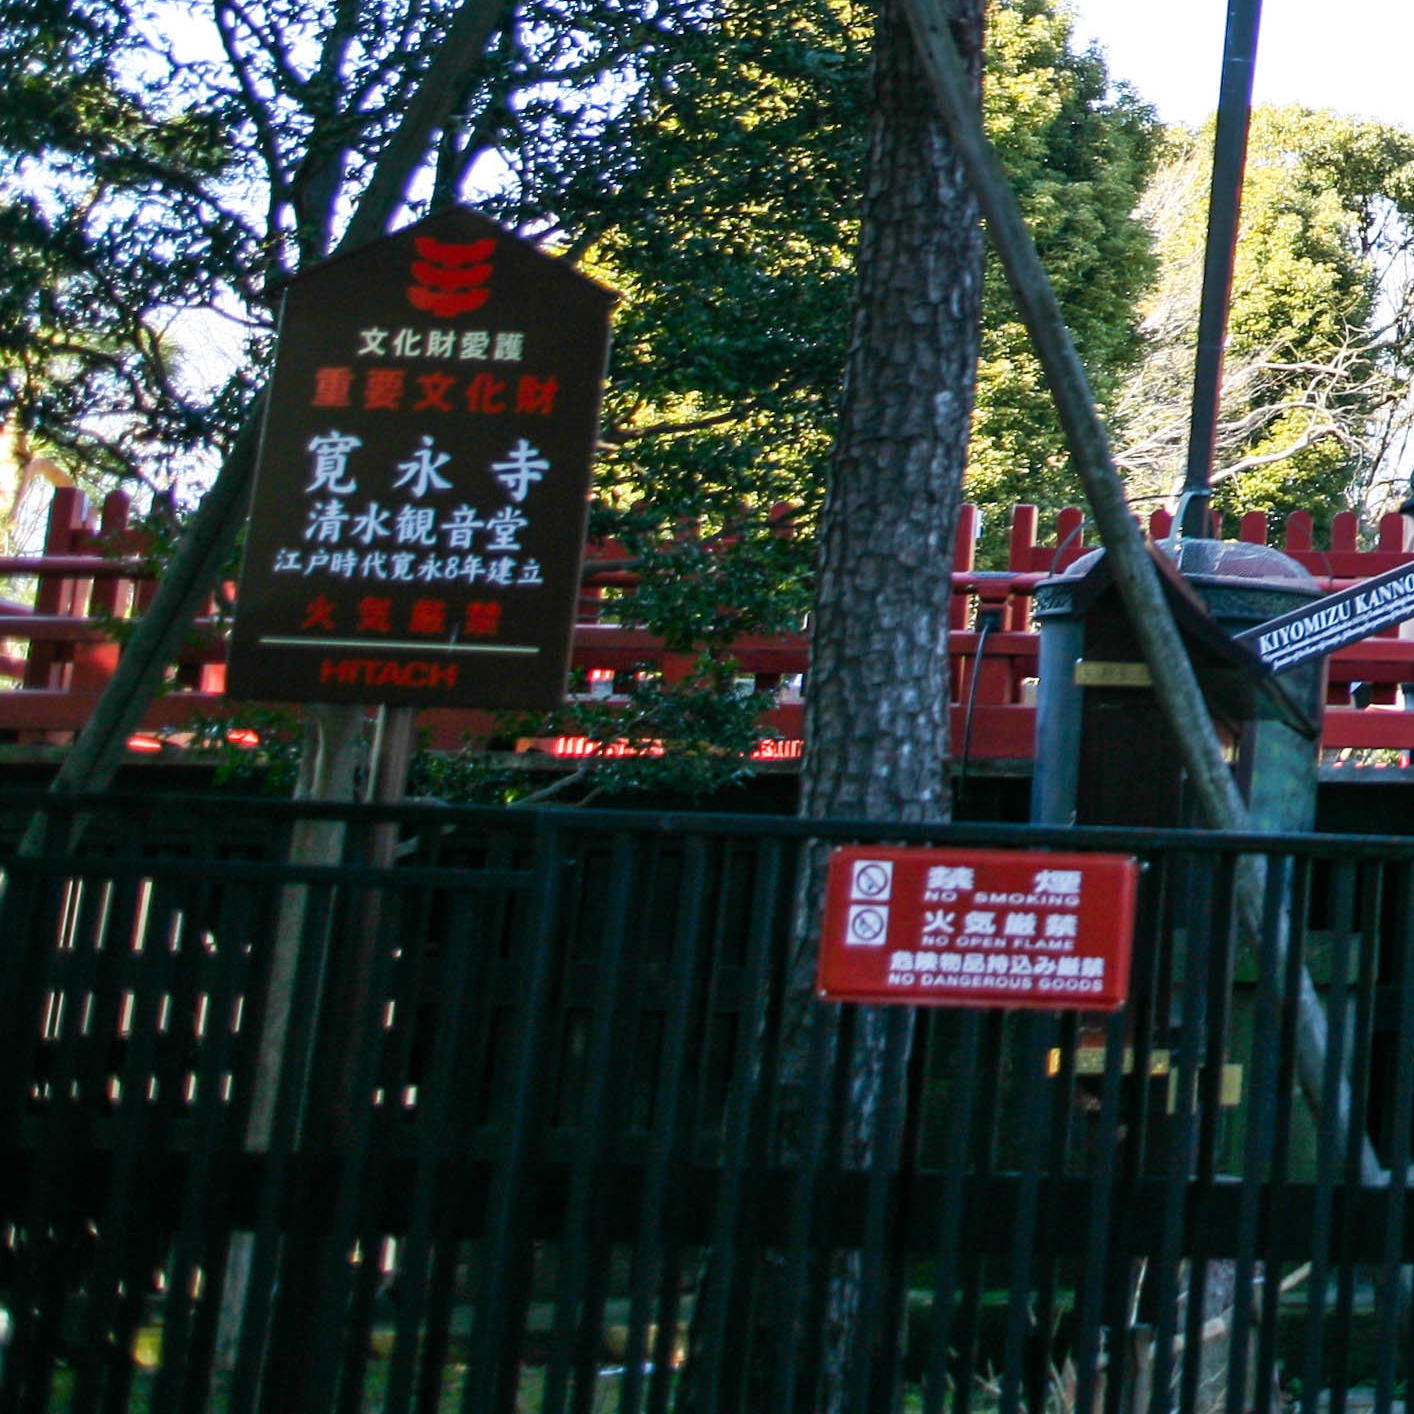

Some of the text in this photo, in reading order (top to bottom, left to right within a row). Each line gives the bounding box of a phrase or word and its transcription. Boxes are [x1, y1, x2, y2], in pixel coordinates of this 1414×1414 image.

[357, 326, 525, 362] 文化財愛護
[312, 366, 559, 415] 重要文化財
[304, 500, 529, 552] 清水観音堂
[1259, 600, 1352, 655] KIYOMIZU
[927, 865, 1083, 894] 禁煙
[924, 890, 1081, 907] NO SMOKING
[921, 909, 1079, 937] 火気厳禁
[921, 935, 1075, 951] NO OPEN FLAME
[887, 973, 1104, 992] NO DANGEROUS GOODS
